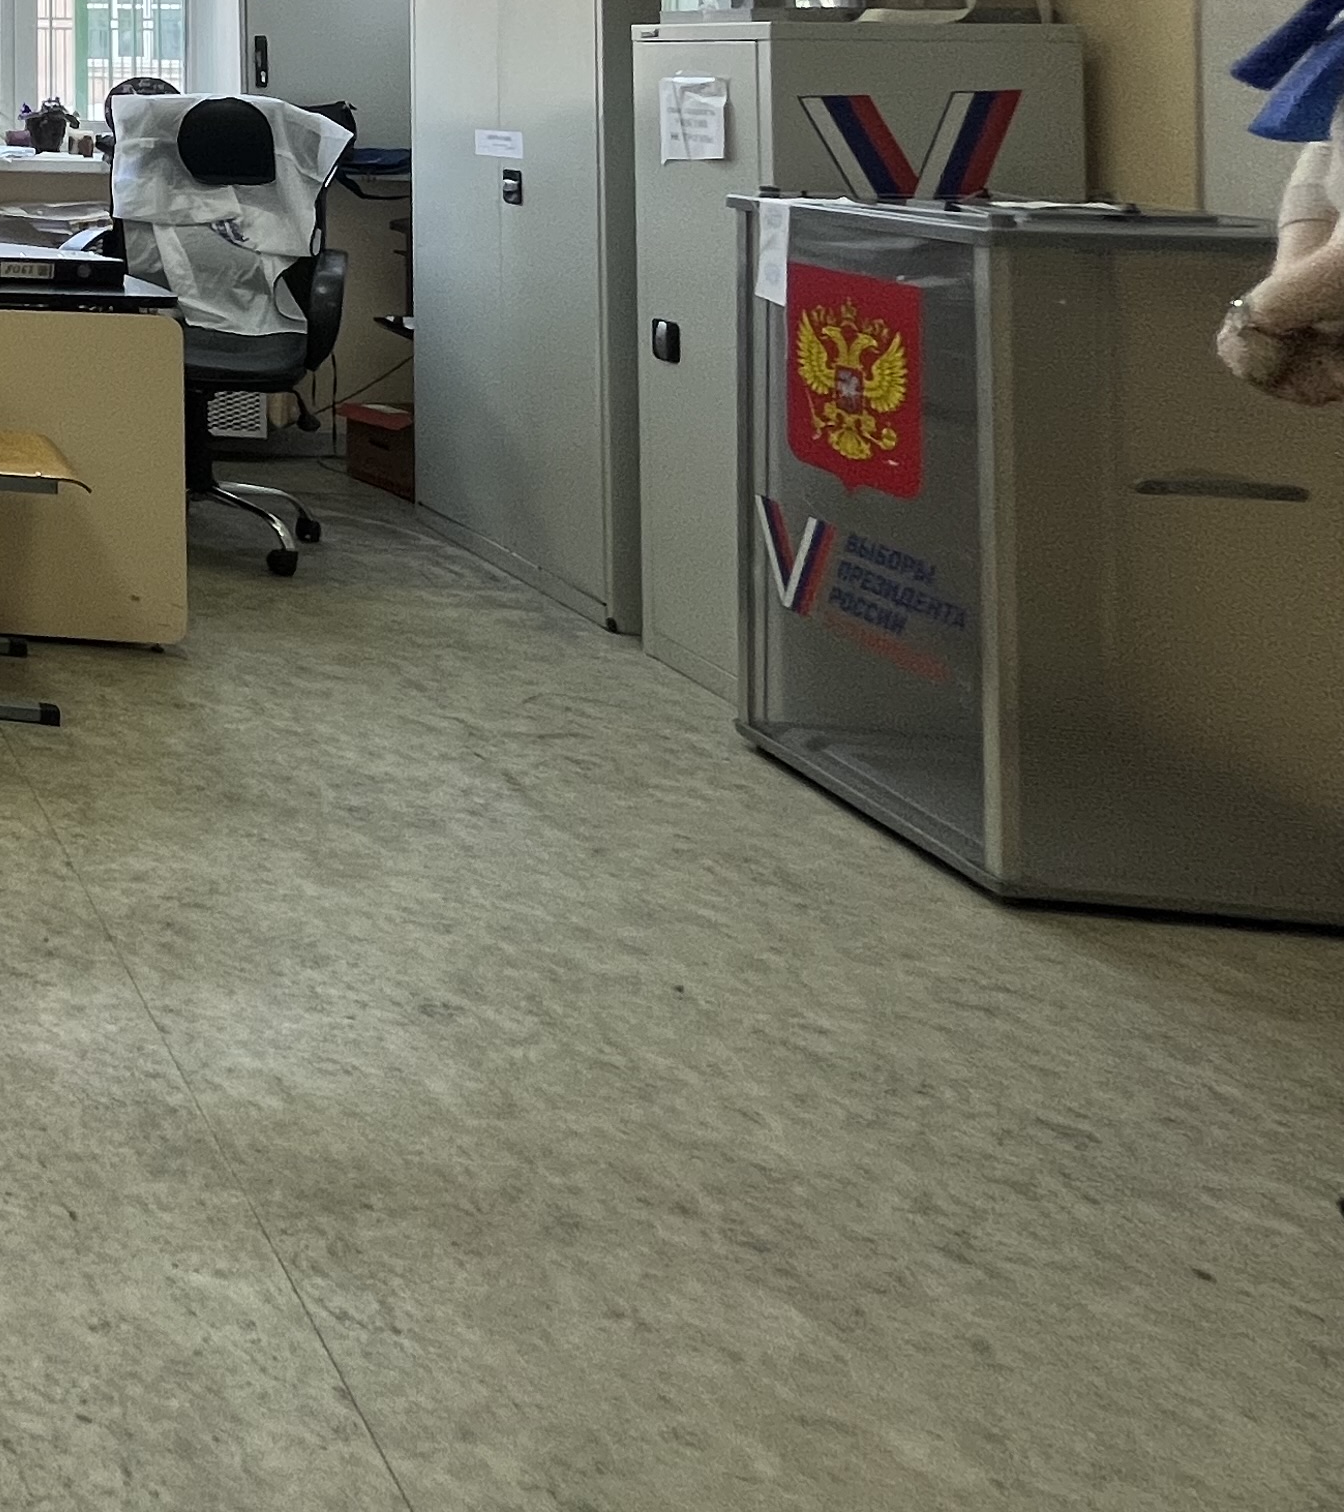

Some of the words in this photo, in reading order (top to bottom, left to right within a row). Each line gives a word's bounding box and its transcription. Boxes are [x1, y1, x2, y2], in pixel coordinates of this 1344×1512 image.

[845, 532, 937, 584] ВЫБОРЫ
[829, 586, 909, 635] РОССИИ
[837, 560, 968, 629] ПРЕЗИДЕНТА
